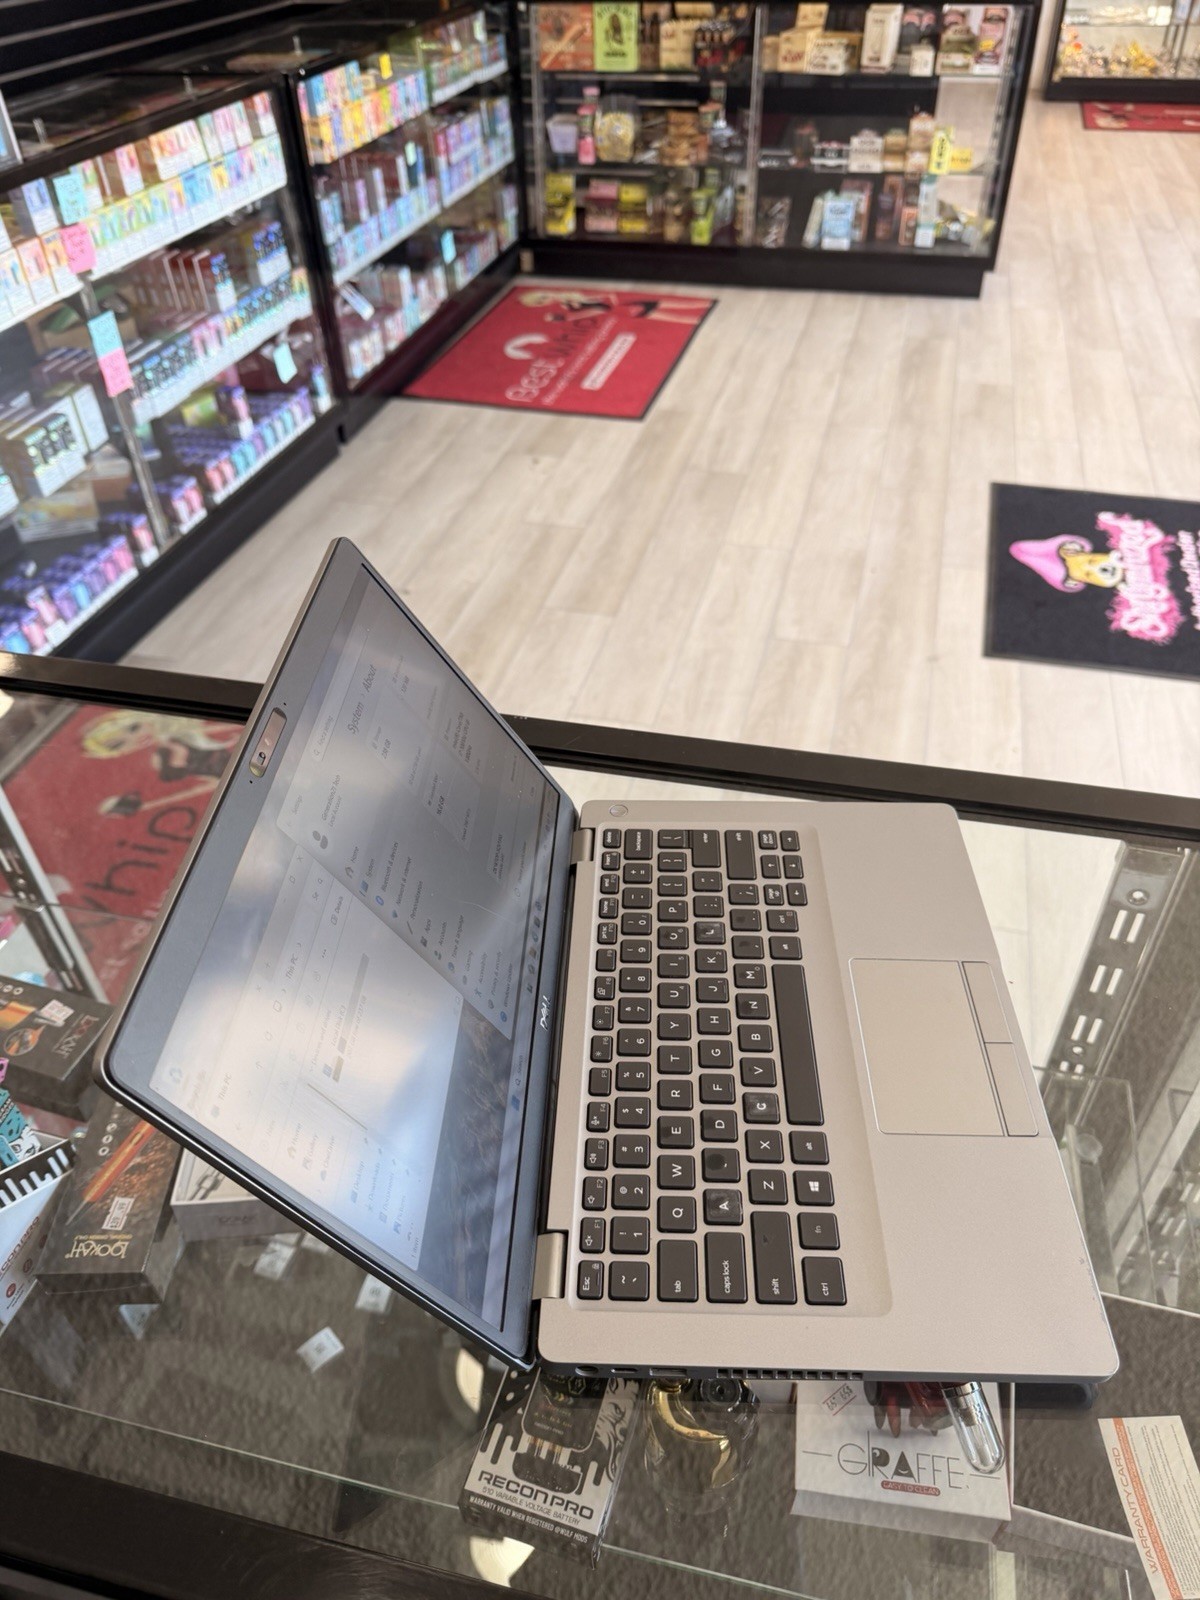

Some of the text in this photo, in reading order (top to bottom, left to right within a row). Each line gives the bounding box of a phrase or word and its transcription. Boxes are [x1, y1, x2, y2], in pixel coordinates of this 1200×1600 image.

[347, 663, 376, 734] System About
[289, 953, 298, 965] PC
[746, 971, 755, 979] M
[748, 1001, 758, 1009] N
[540, 995, 550, 1031] DELL
[670, 1021, 679, 1029] Y
[711, 1048, 721, 1057] G
[670, 1054, 680, 1062] T
[754, 1066, 763, 1075] V
[713, 1083, 722, 1091] F
[671, 1089, 681, 1097] R
[715, 1119, 725, 1129] D
[671, 1126, 681, 1134] E
[760, 1140, 771, 1149] X
[805, 1142, 813, 1151] alt
[672, 1163, 682, 1177] W
[597, 1178, 603, 1189] F2
[763, 1180, 774, 1190] Z
[719, 1201, 730, 1210] A
[672, 1207, 684, 1218] Q
[594, 1219, 601, 1229] F1
[815, 1225, 822, 1233] fn
[70, 1240, 129, 1259] LOOKAH
[821, 1282, 829, 1296] ctrl
[837, 1430, 964, 1489] GIRAFFE
[883, 1481, 939, 1495] EASY TO CLEAN
[482, 1486, 581, 1525] 510 VARIABLE VOLTAGE BATTERY
[1112, 1446, 1159, 1575] WARRANTY CARD
[469, 1495, 589, 1544] WARRANTY VALID WHEN REGISTERED @WULF MODS
